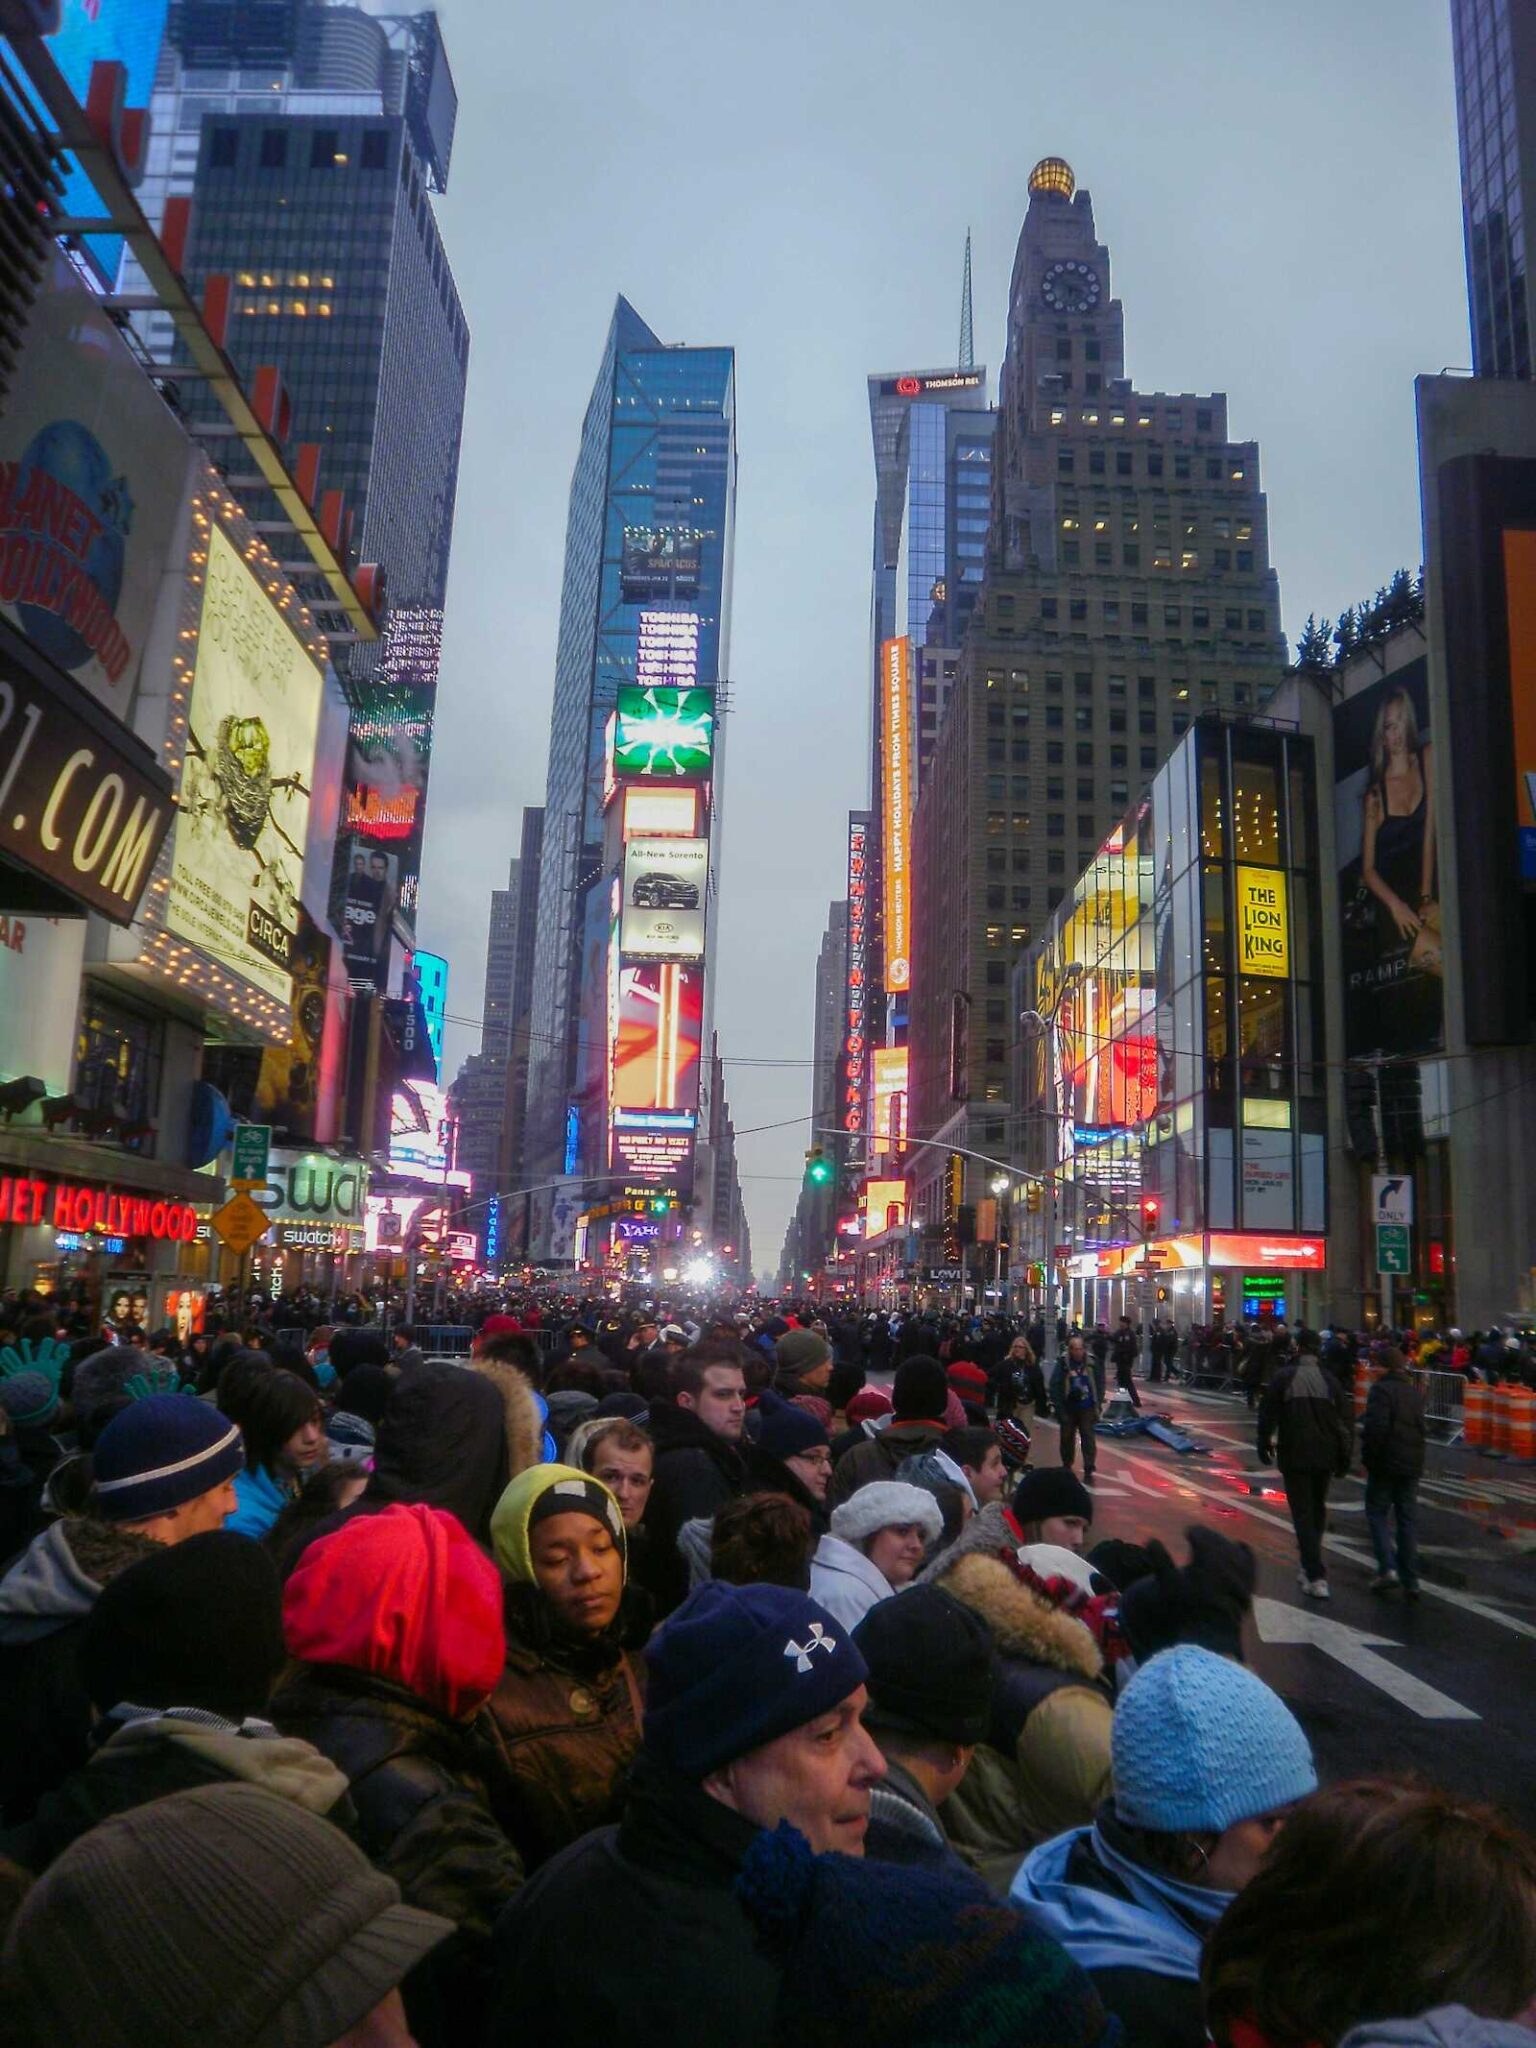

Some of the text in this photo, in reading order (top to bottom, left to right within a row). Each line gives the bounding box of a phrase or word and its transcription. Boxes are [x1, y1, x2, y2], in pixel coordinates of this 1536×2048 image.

[925, 378, 964, 389] THOMSON
[0, 460, 104, 562] LANET
[647, 558, 698, 569] SPARACUS
[0, 537, 131, 688] OLLYWOOD
[640, 612, 699, 624] TOSHIBA
[639, 624, 698, 637] TOSHIBA
[638, 649, 697, 662] TOSHIBA
[891, 644, 899, 693] SQUARE
[636, 674, 695, 687] TOSHIBA
[892, 732, 900, 767] FROM
[893, 768, 901, 829] HOLIDAYS
[631, 849, 704, 860] All-New Sorento
[894, 830, 903, 873] HAPPY
[1247, 886, 1276, 904] THE
[1244, 905, 1281, 931] LION
[250, 909, 289, 958] CIRCA
[895, 915, 903, 954] THOMSON
[1244, 933, 1282, 960] KING
[54, 1183, 197, 1242] HOLLYWOOD
[1378, 1209, 1407, 1222] ONLY
[619, 1222, 682, 1238] YAHO!
